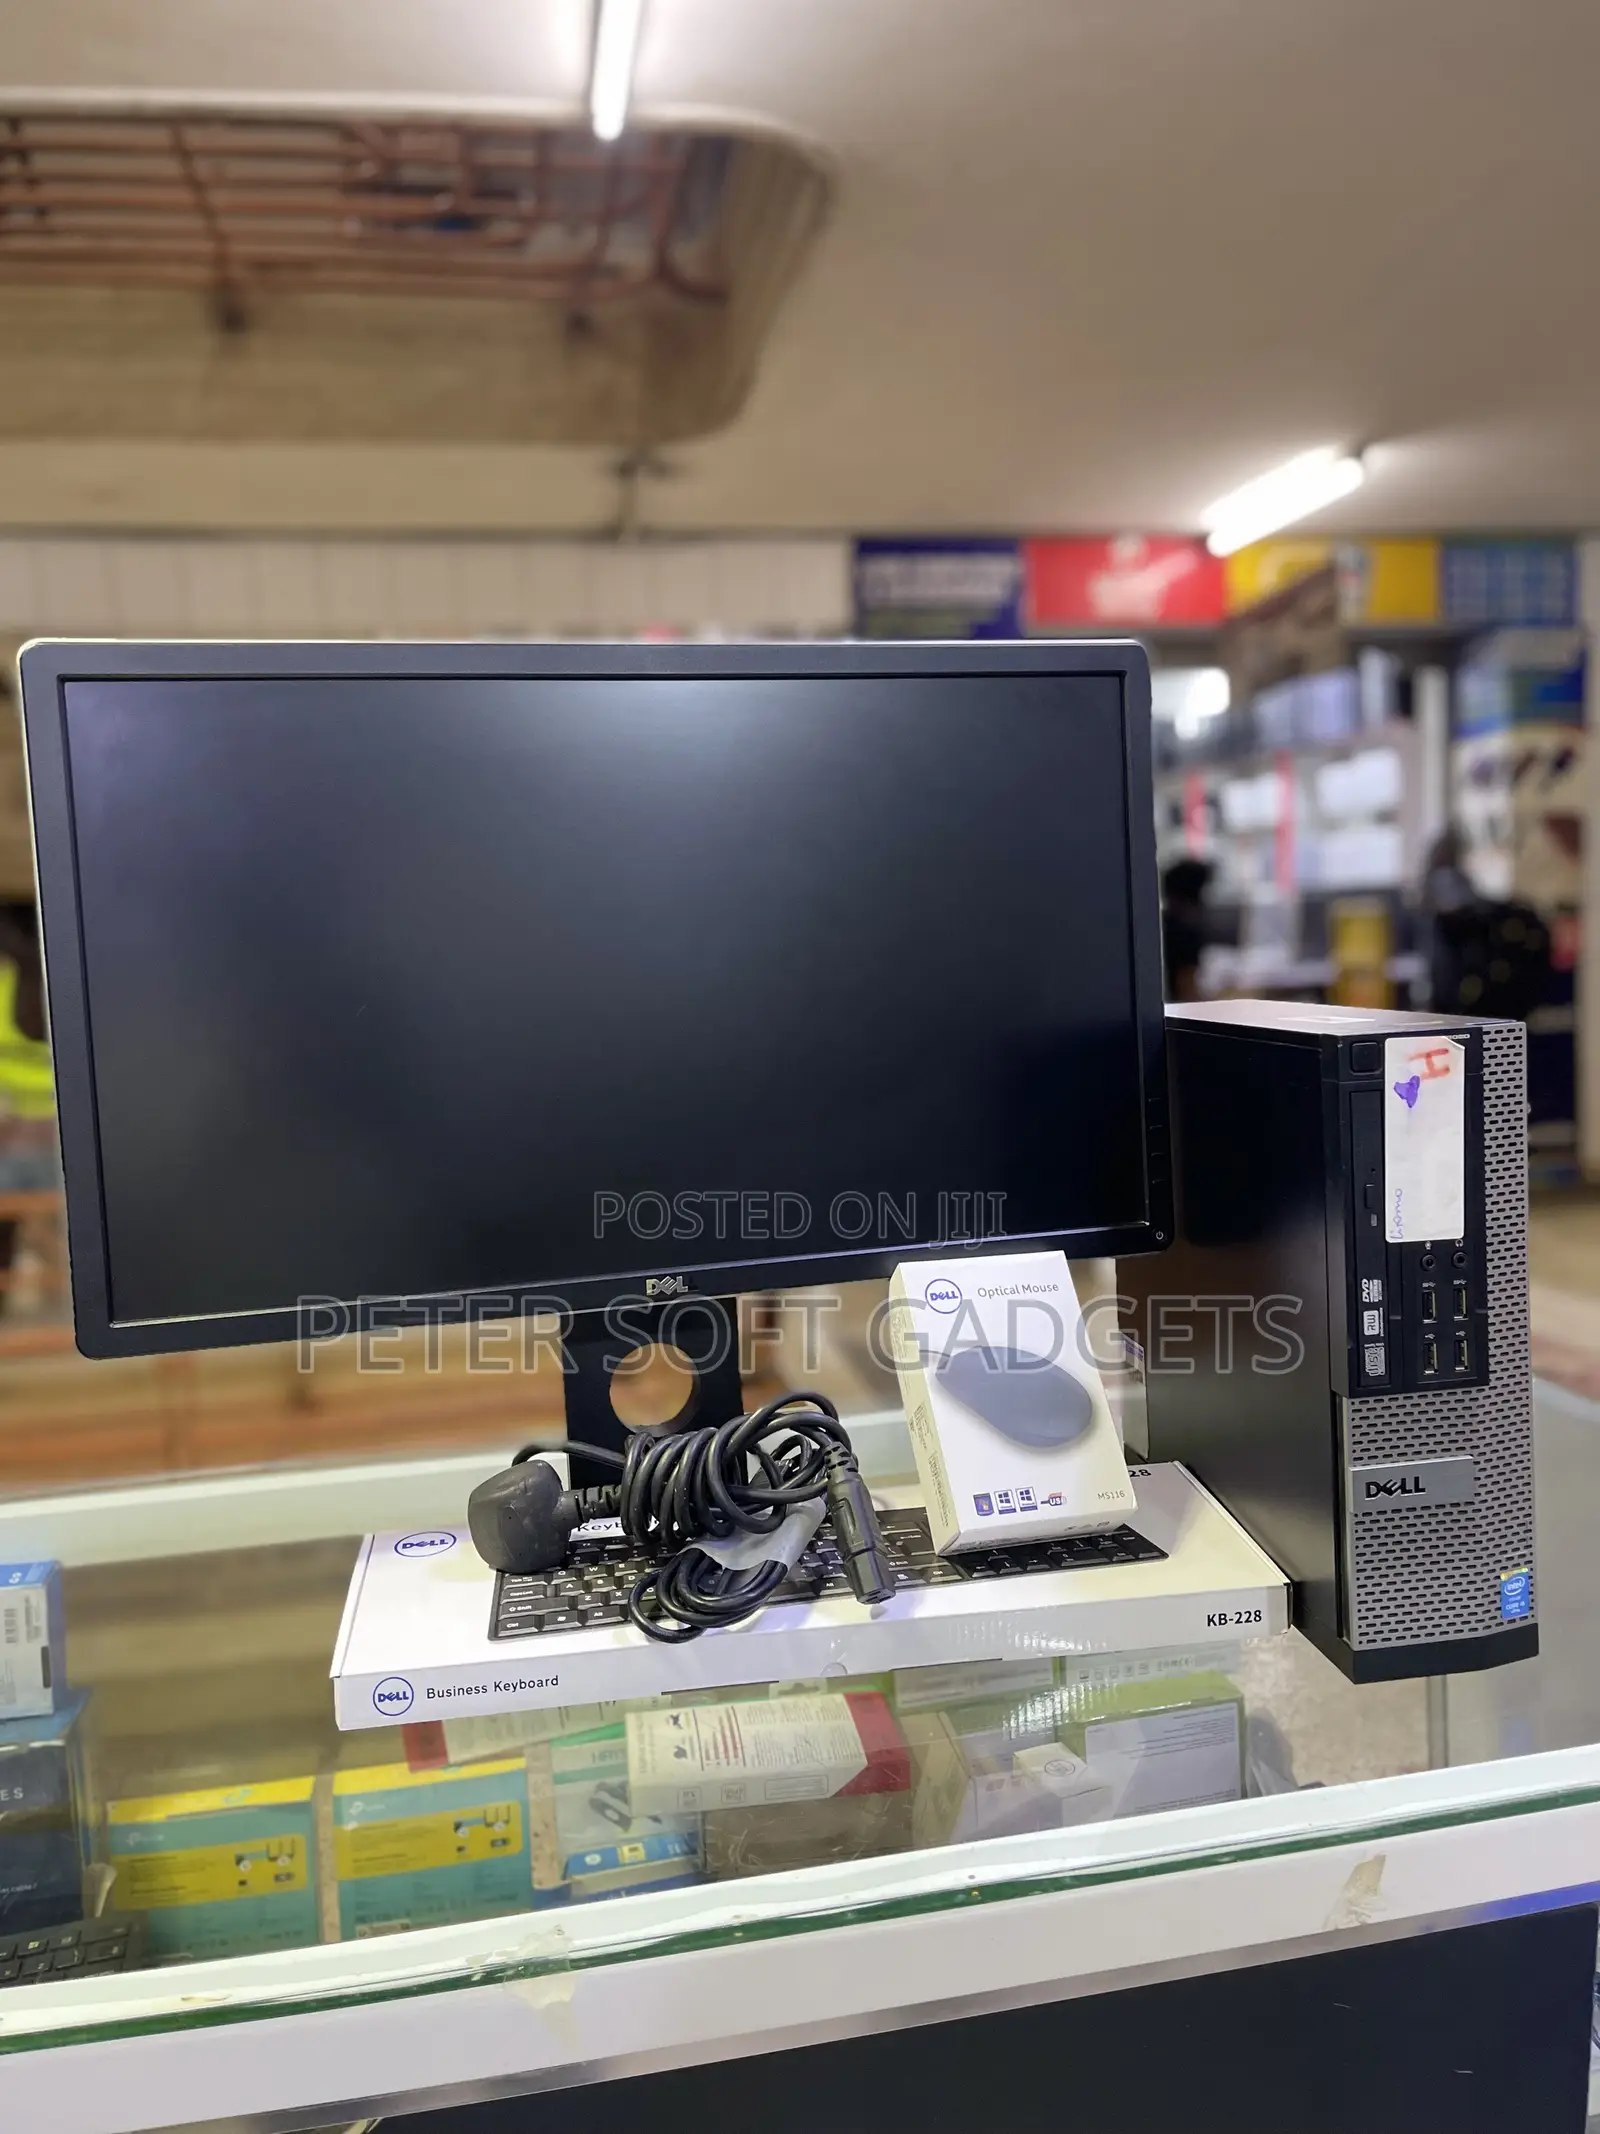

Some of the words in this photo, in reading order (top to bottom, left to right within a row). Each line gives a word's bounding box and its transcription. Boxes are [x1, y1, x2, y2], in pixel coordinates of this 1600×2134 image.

[977, 1283, 1020, 1300] Optical
[1021, 1282, 1060, 1295] Mouse
[1097, 1489, 1126, 1501] MS116
[1365, 1475, 1426, 1499] DELL
[401, 1537, 450, 1550] DELL
[1206, 1609, 1263, 1628] KB-228
[426, 1683, 488, 1699] Business
[493, 1675, 560, 1693] Keyboard
